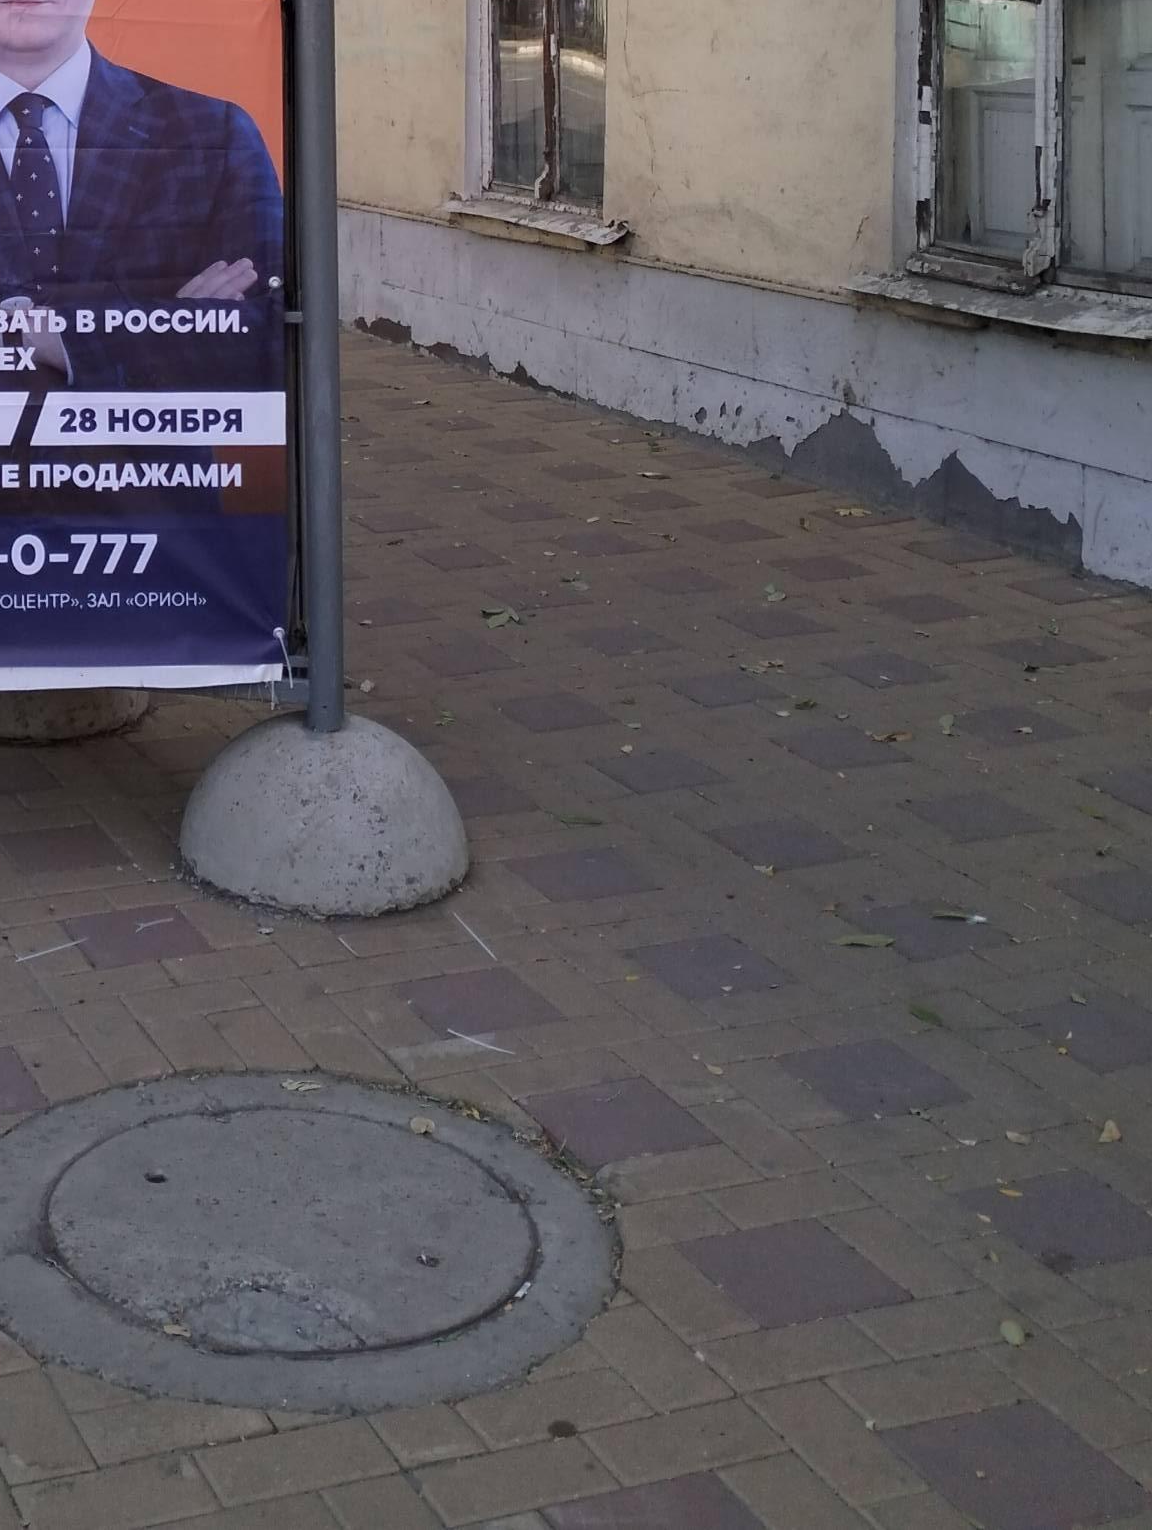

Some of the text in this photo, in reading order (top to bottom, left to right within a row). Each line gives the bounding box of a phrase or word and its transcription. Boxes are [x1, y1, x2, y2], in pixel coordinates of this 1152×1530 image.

[76, 309, 96, 333] В
[104, 309, 249, 334] РОССИИ.
[59, 408, 243, 433] 28 НОЯБРЯ
[29, 462, 242, 492] ПРОДАЖАМИ
[87, 592, 120, 608] ЗАЛ
[125, 591, 207, 609] «ОРИОН»
